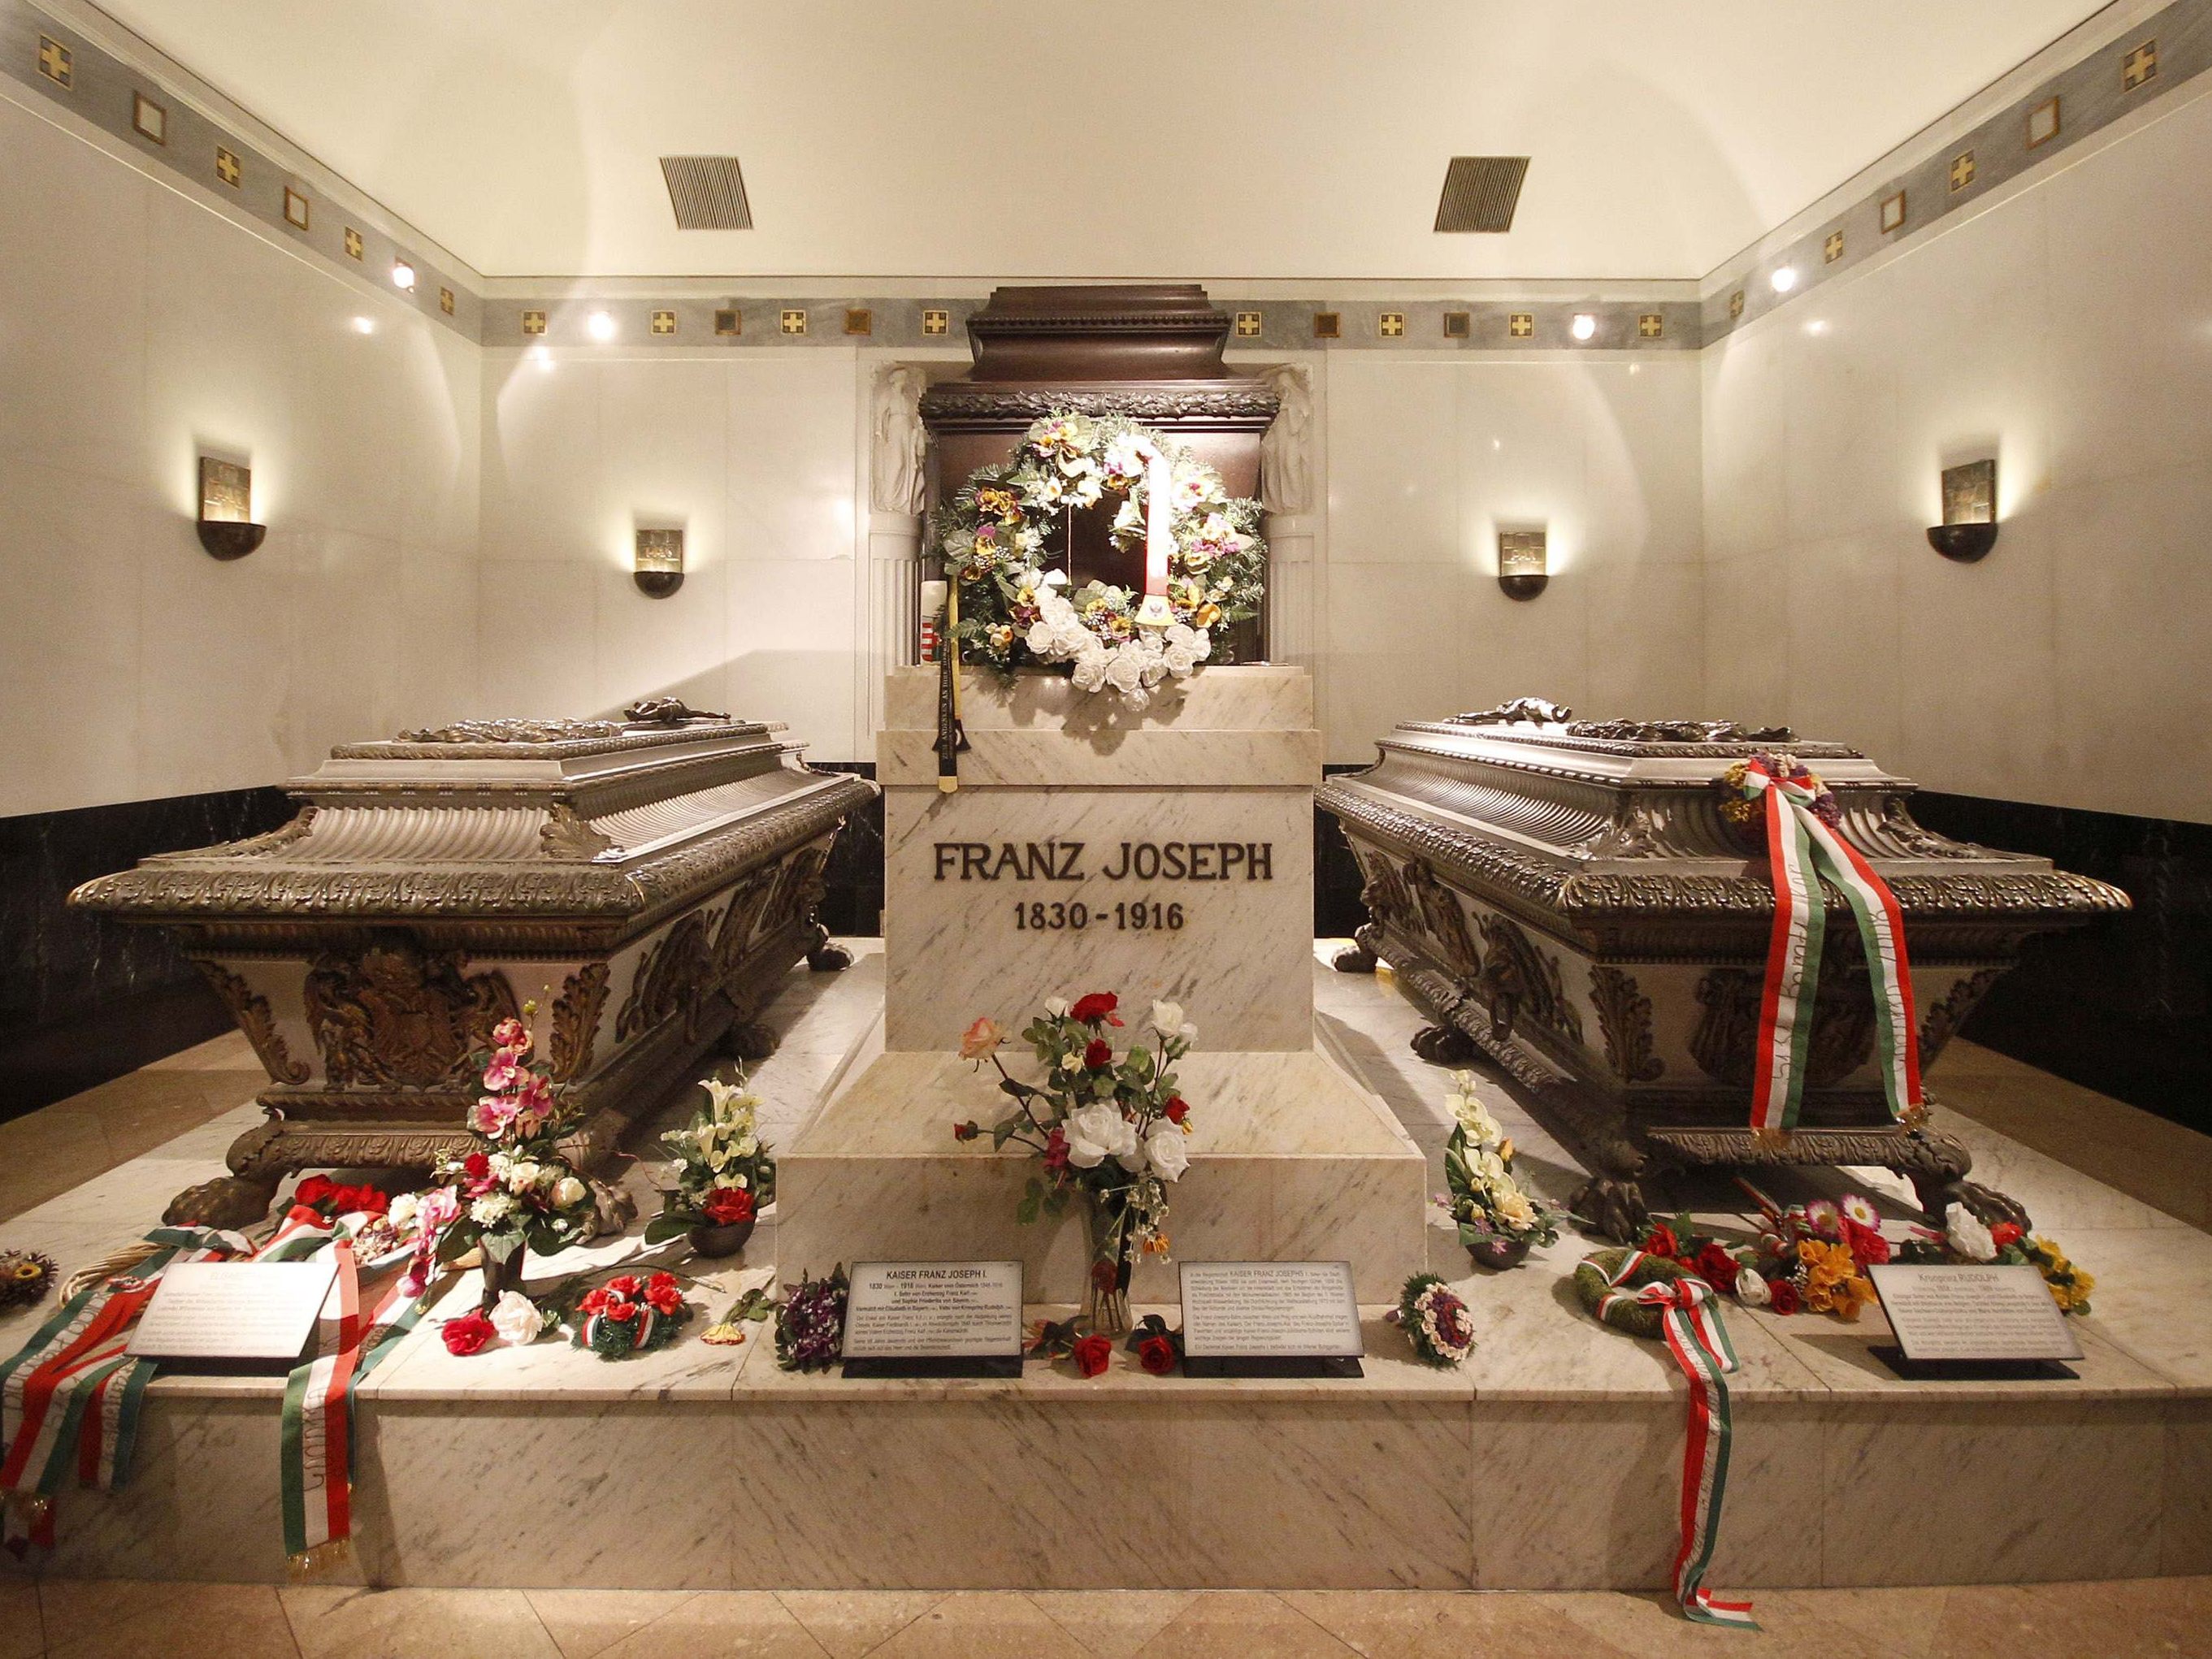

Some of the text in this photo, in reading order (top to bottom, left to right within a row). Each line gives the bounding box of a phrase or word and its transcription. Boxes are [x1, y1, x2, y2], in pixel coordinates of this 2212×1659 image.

[933, 842, 1273, 881] FRANZ JOSEPH
[886, 1270, 917, 1280] KAISER
[918, 1270, 946, 1279] FRANZ
[948, 1269, 981, 1279] JOSEPH
